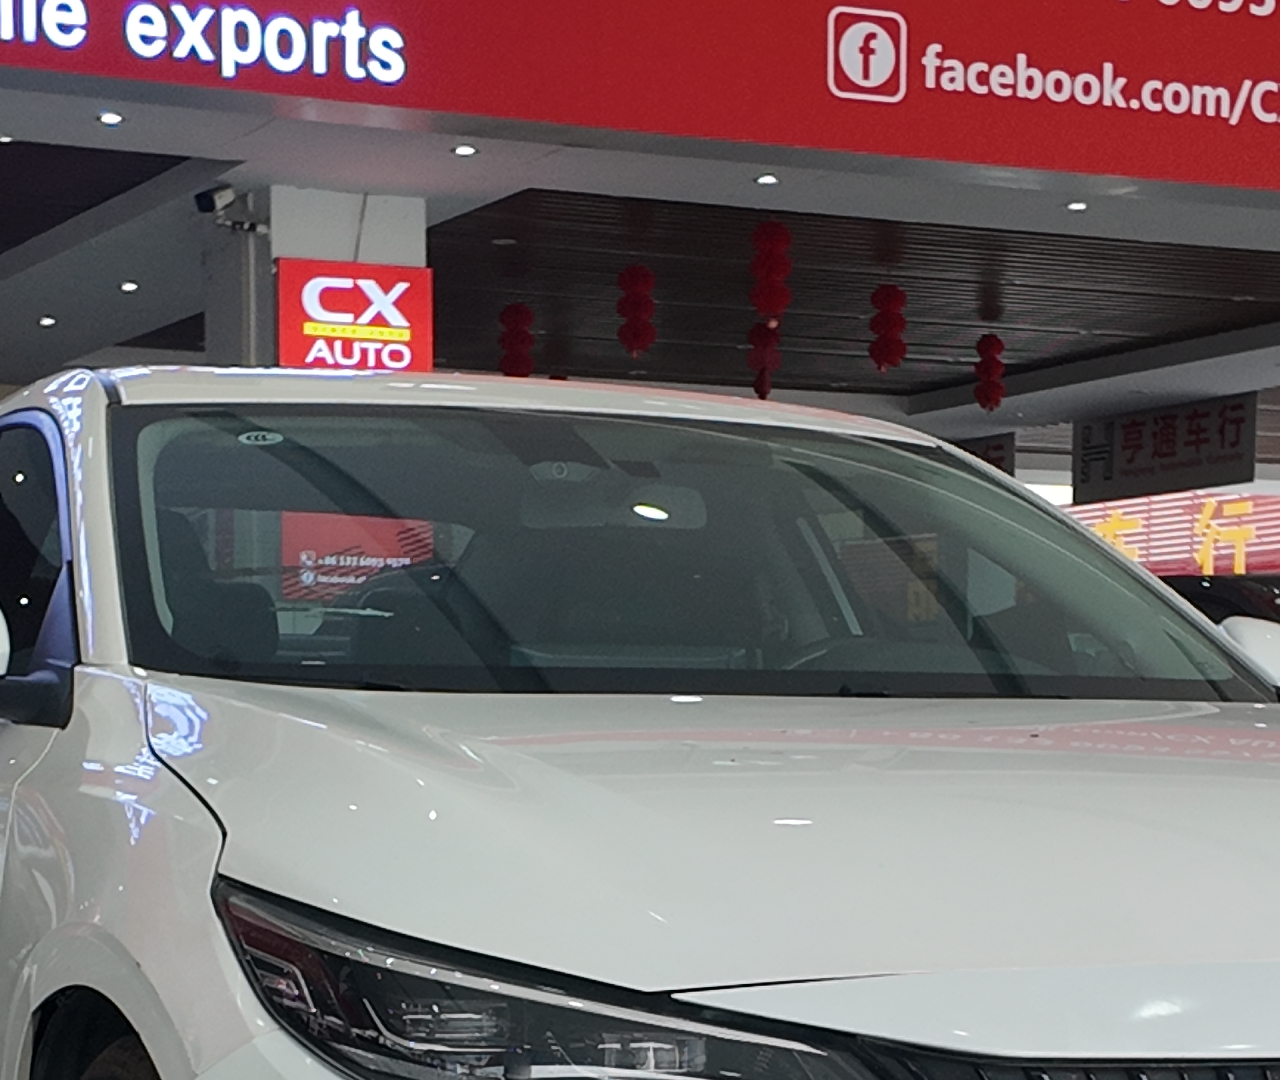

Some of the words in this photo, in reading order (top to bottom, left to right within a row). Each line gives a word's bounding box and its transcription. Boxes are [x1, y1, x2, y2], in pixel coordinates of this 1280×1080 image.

[125, 2, 406, 83] exports
[301, 276, 411, 327] CX
[304, 338, 412, 369] AUTO
[1120, 402, 1247, 464] 亨通车行
